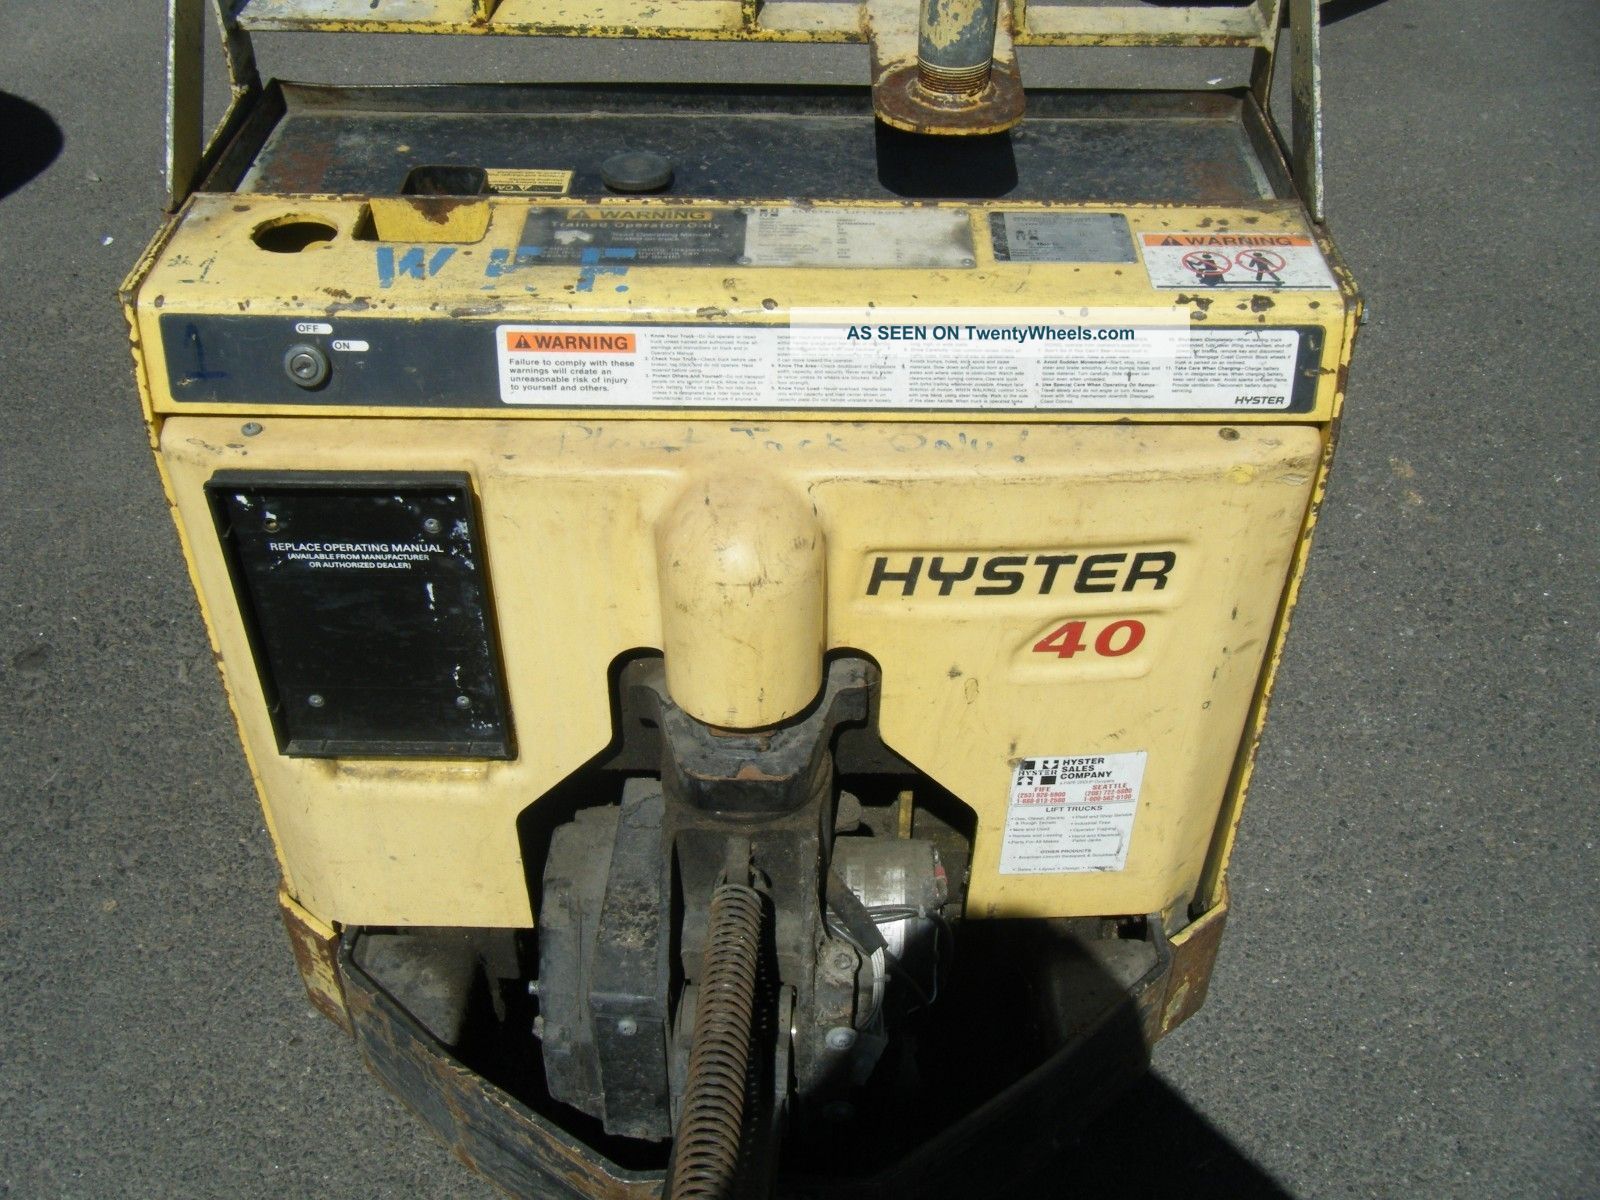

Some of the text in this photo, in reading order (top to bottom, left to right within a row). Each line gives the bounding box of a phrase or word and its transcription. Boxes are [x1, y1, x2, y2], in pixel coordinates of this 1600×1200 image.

[600, 210, 706, 219] WARNING
[1185, 236, 1292, 246] WARNING
[297, 324, 320, 333] OFF
[334, 342, 350, 350] ON
[534, 335, 628, 350] WARNING
[509, 358, 540, 366] Failure
[554, 359, 587, 368] comply
[509, 367, 549, 375] warnings
[510, 375, 570, 383] unreasonable
[603, 377, 628, 385] injury
[522, 384, 557, 392] yourself
[1234, 396, 1285, 405] HYSTER
[270, 542, 444, 553] REPLACE OPERATING MANUAL
[377, 562, 412, 570] DEALER)
[865, 551, 1177, 596] HYSTER
[1031, 619, 1146, 659] 40
[1063, 757, 1105, 766] HYSTER
[1060, 771, 1113, 780] COMPANY
